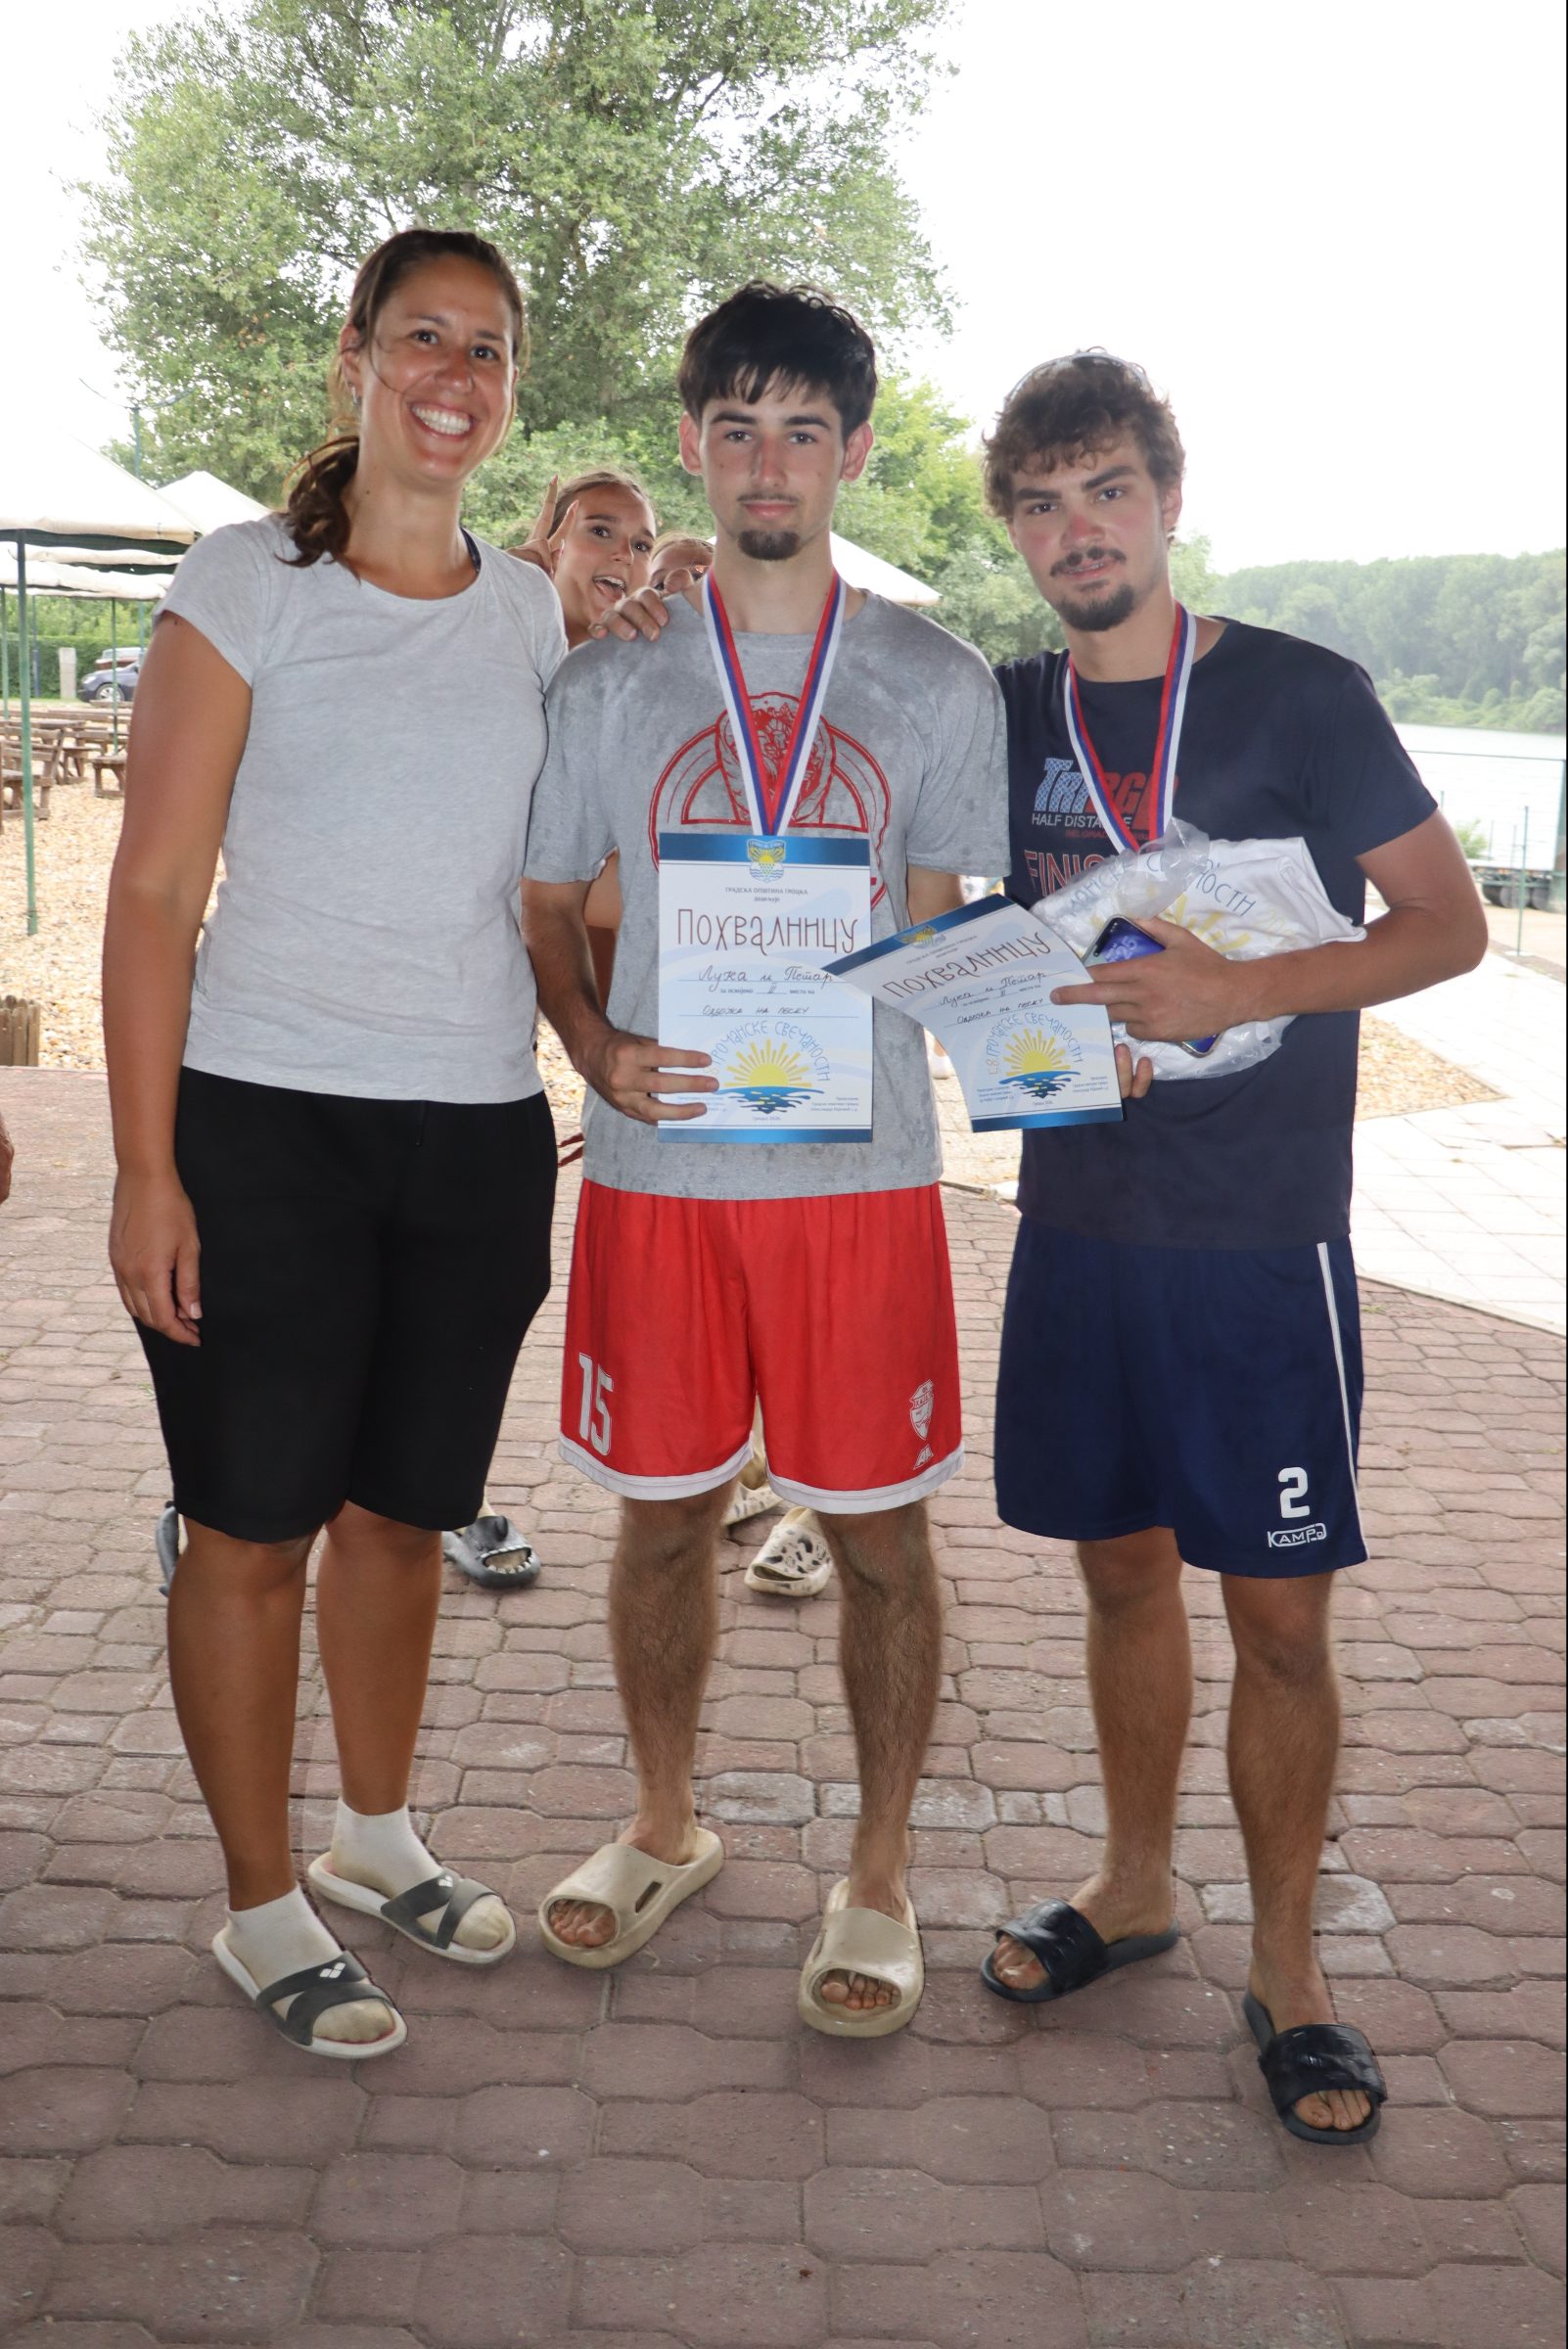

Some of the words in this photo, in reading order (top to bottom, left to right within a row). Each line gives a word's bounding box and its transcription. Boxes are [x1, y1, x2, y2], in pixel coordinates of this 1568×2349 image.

[1032, 812, 1062, 826] HALF
[1064, 815, 1132, 830] DISTAE
[578, 1352, 614, 1455] 15
[1277, 1466, 1311, 1519] 2
